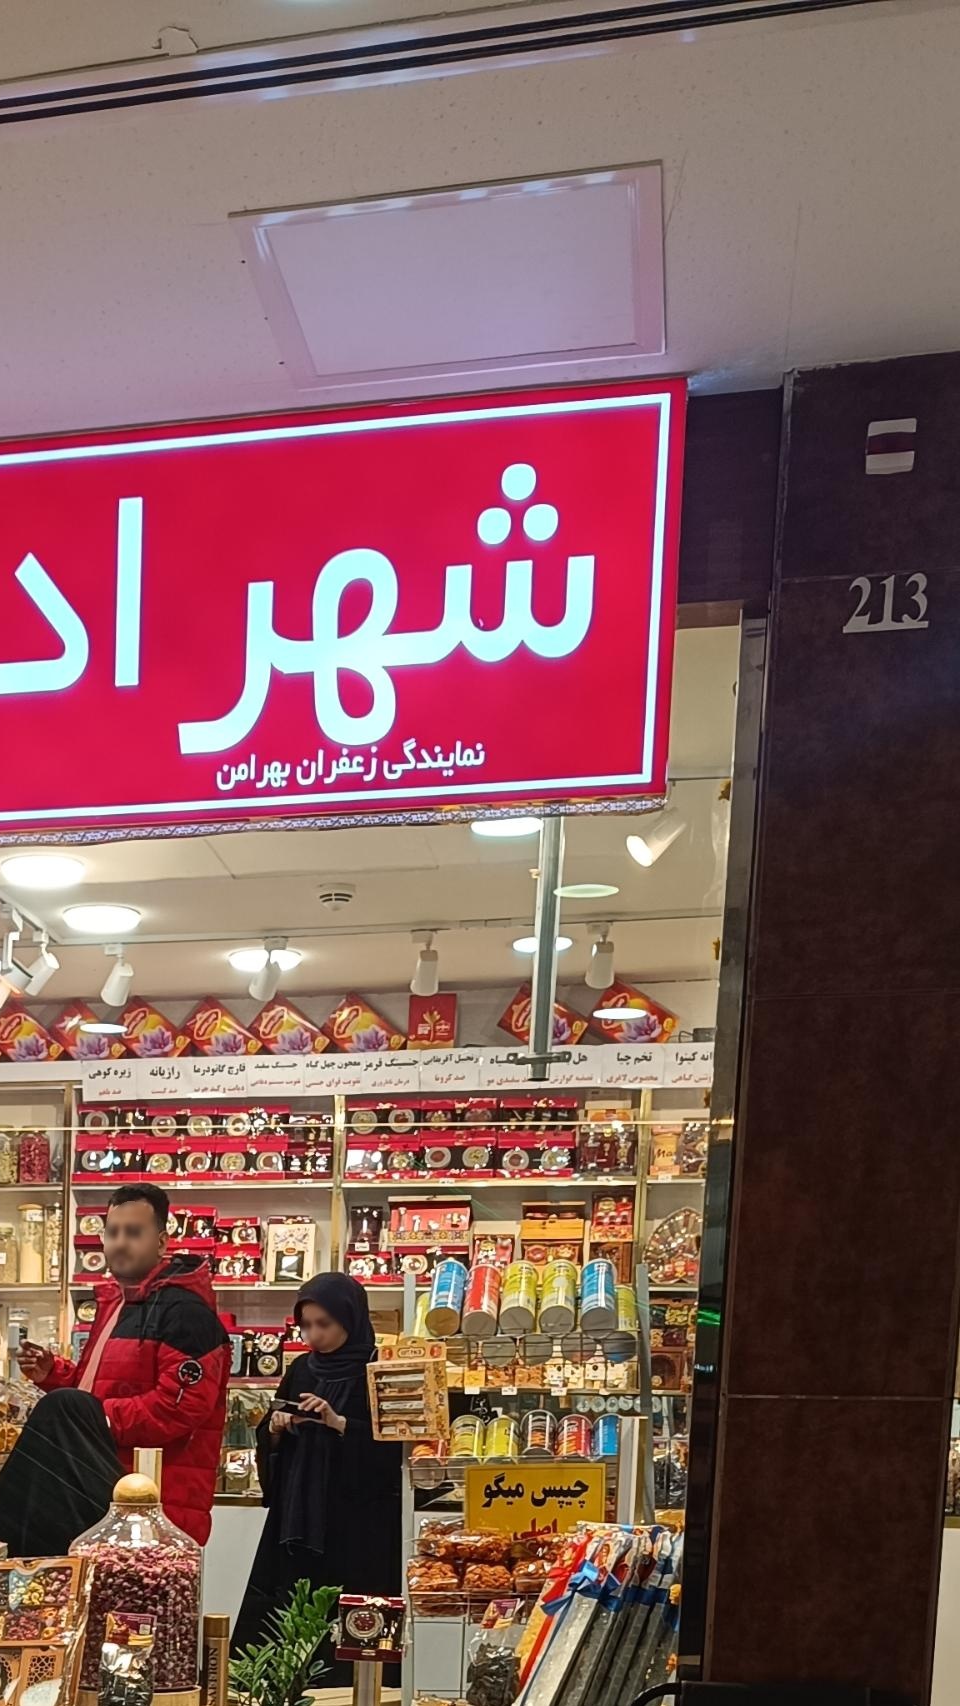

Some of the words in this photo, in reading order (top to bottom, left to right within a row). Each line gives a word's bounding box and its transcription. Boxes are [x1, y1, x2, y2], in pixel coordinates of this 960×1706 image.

[178, 463, 596, 754] شهر
[843, 572, 928, 634] 213
[216, 753, 291, 791] بهرامن
[296, 745, 378, 786] زعفران
[383, 738, 486, 780] نمایندگی
[88, 1067, 112, 1080] کوهی
[113, 1067, 132, 1079] زیره
[149, 1066, 181, 1080] رازیانه
[481, 1472, 525, 1508] میگو
[530, 1479, 589, 1509] چیپس
